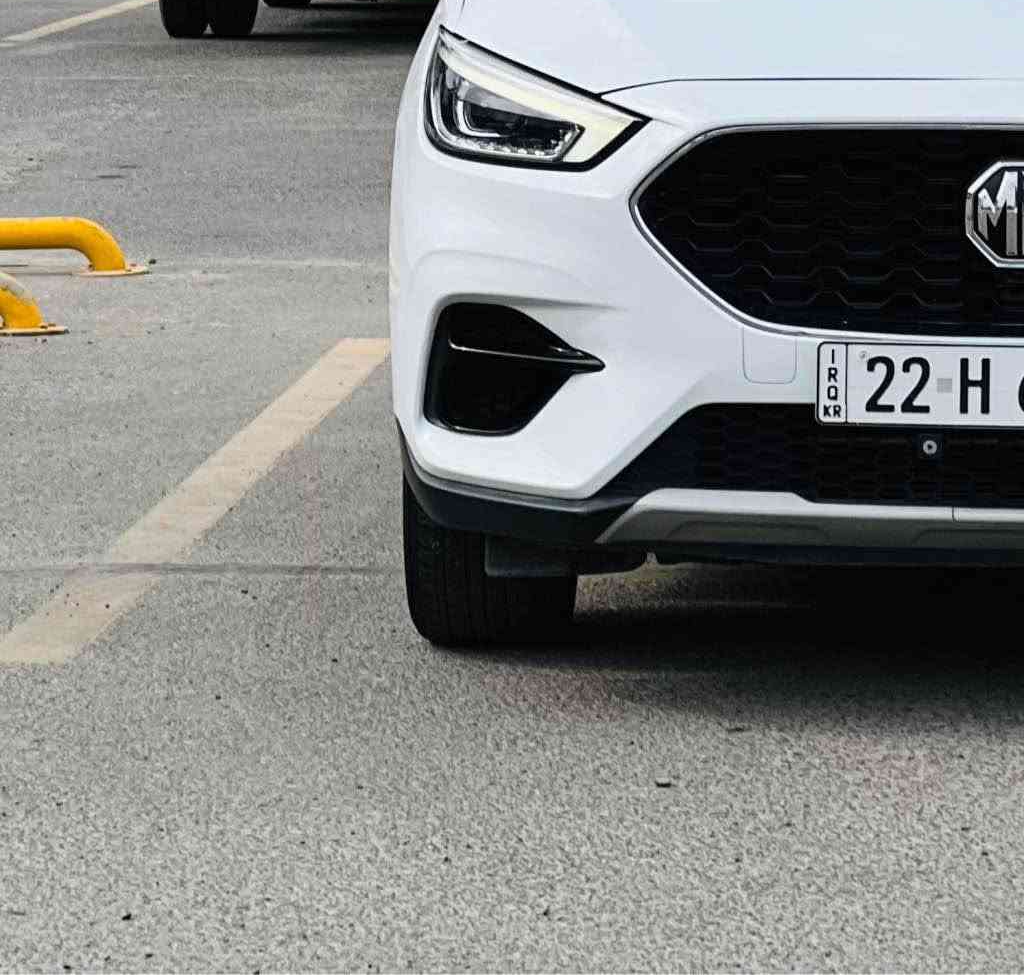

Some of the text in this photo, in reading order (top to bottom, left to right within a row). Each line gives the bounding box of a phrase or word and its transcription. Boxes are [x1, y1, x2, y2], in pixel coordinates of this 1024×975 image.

[865, 356, 931, 414] 22
[959, 358, 991, 415] H
[823, 404, 842, 418] KR
